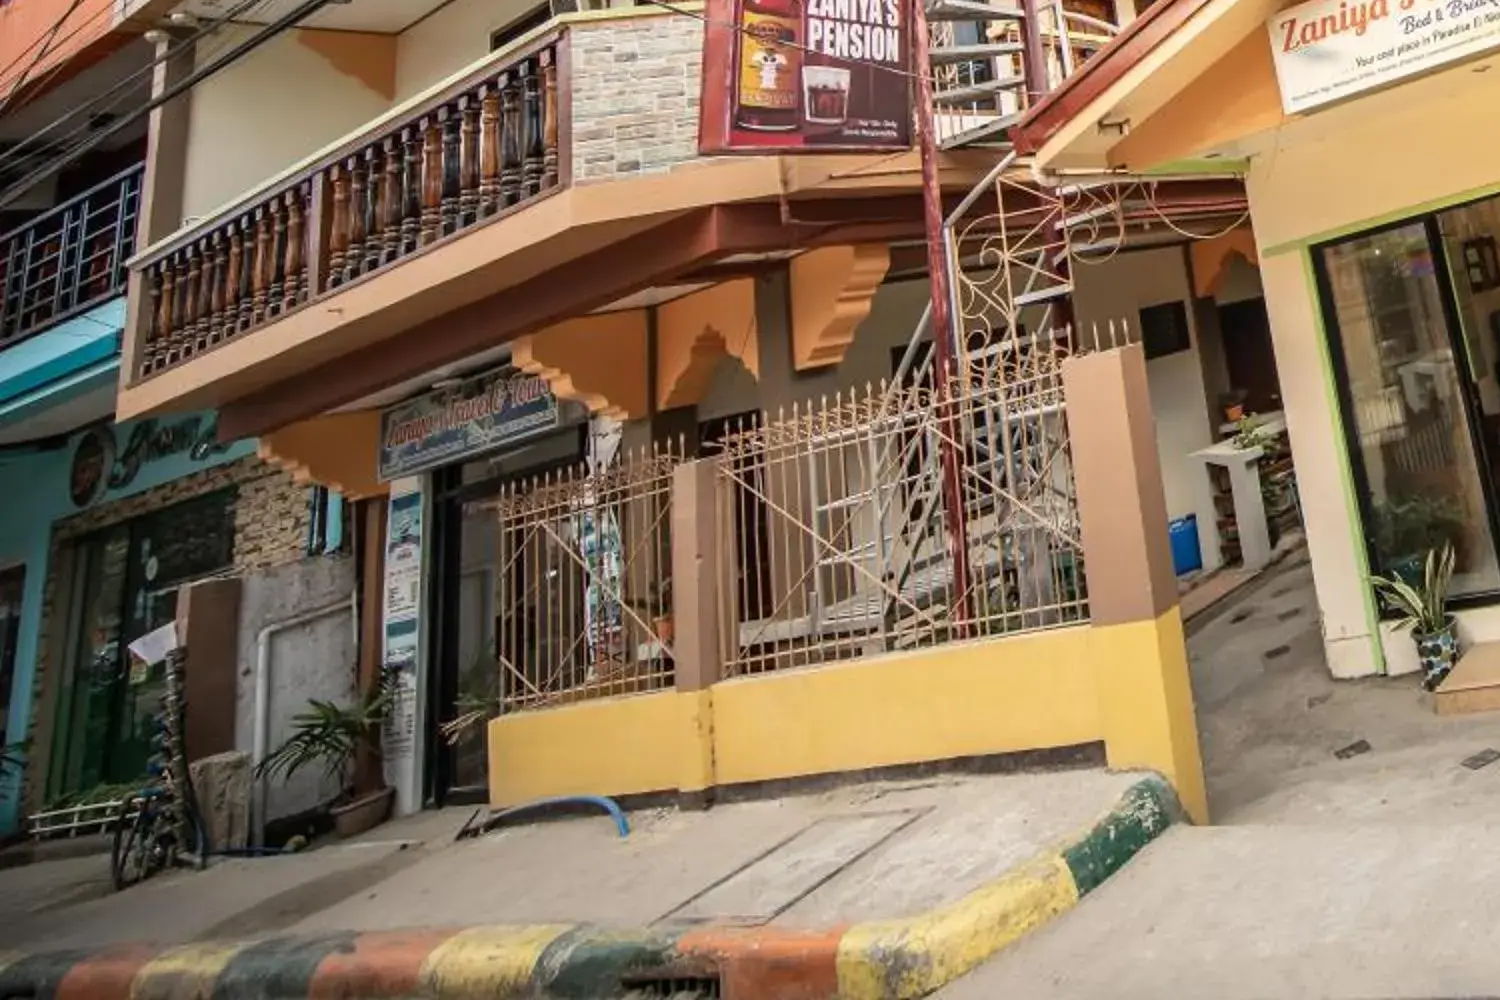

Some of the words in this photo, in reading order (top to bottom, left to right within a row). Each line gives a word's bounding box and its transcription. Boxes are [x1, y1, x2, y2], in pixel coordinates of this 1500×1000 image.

[1400, 12, 1432, 35] Bed
[1435, 8, 1444, 21] &
[807, 18, 899, 62] PENSION
[1397, 39, 1421, 56] place
[1422, 34, 1431, 46] in
[1432, 22, 1470, 42] Paradise
